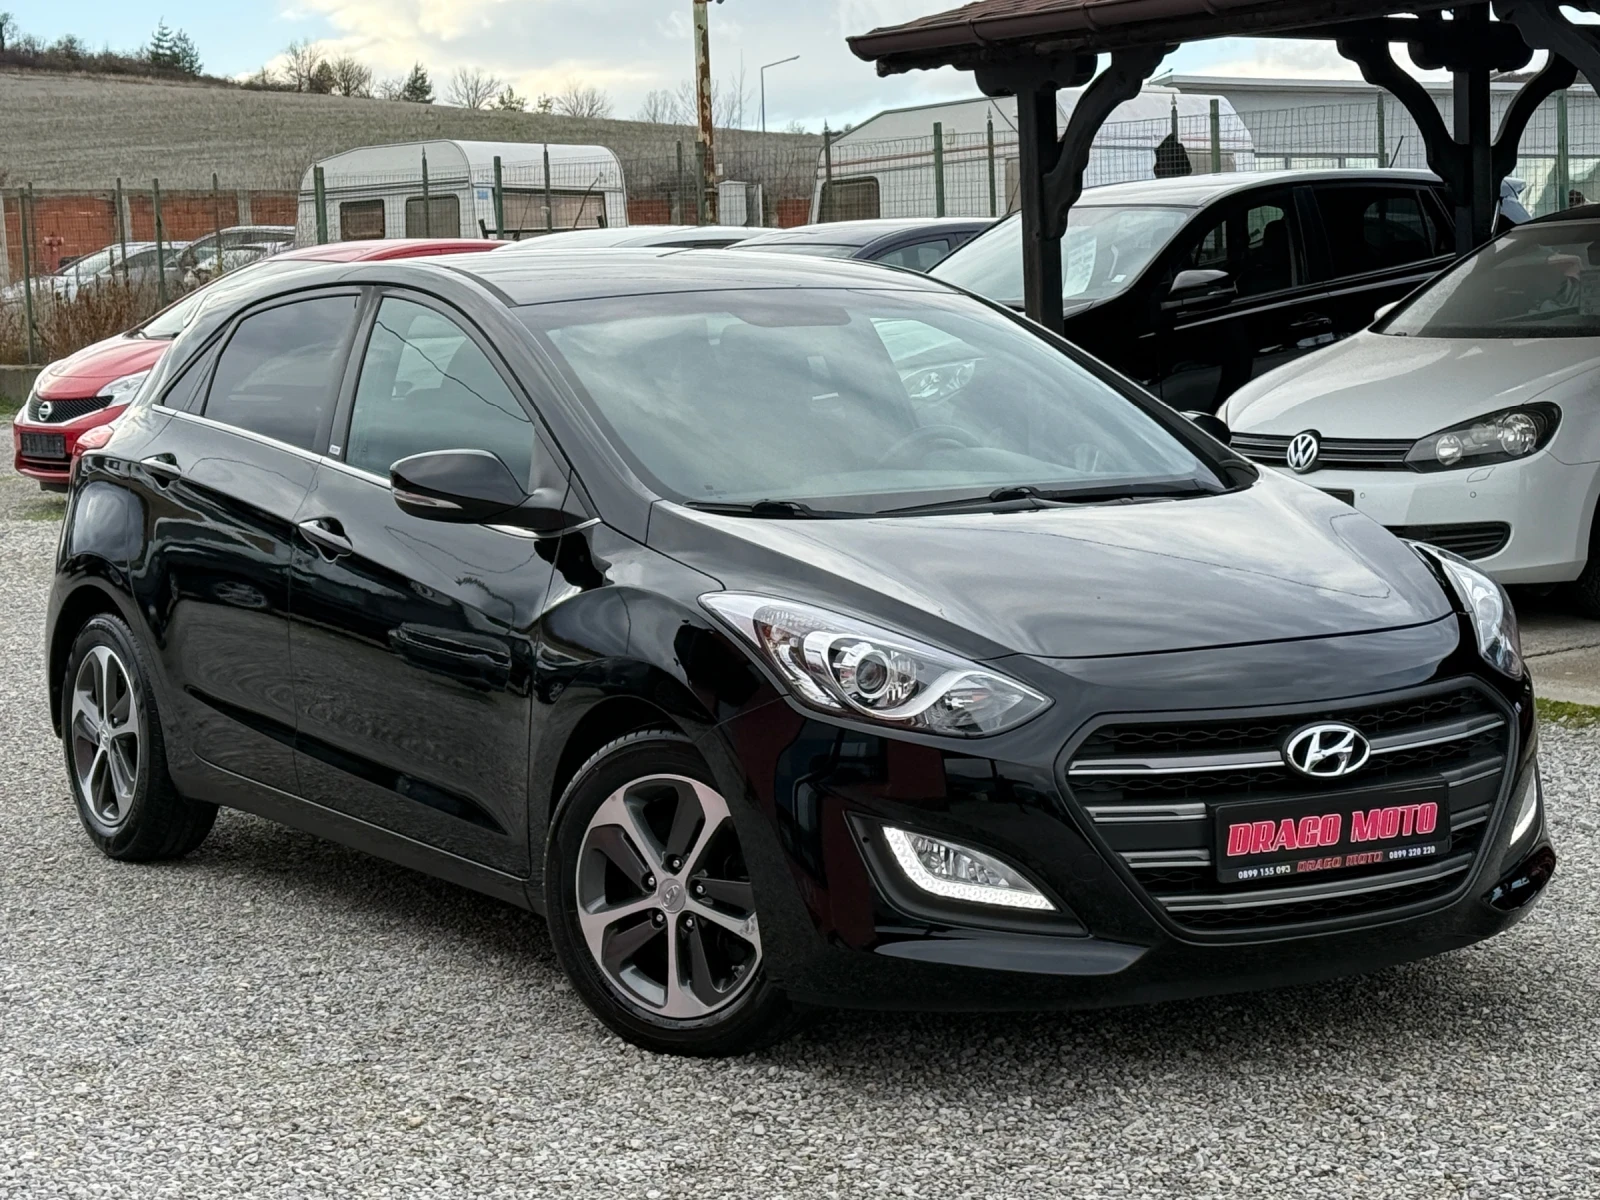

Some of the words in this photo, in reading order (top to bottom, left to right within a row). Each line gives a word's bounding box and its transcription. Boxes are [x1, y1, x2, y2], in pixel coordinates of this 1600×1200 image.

[1227, 814, 1341, 856] DRAGO
[1350, 802, 1438, 842] MOTO
[1238, 869, 1258, 879] 0899
[1260, 867, 1274, 876] 155
[1275, 865, 1291, 874] 093
[1297, 856, 1342, 872] DRAGO
[1346, 851, 1383, 867] MOTO
[1389, 850, 1407, 859] 0899
[1408, 847, 1421, 857] 320
[1422, 845, 1436, 854] 220
